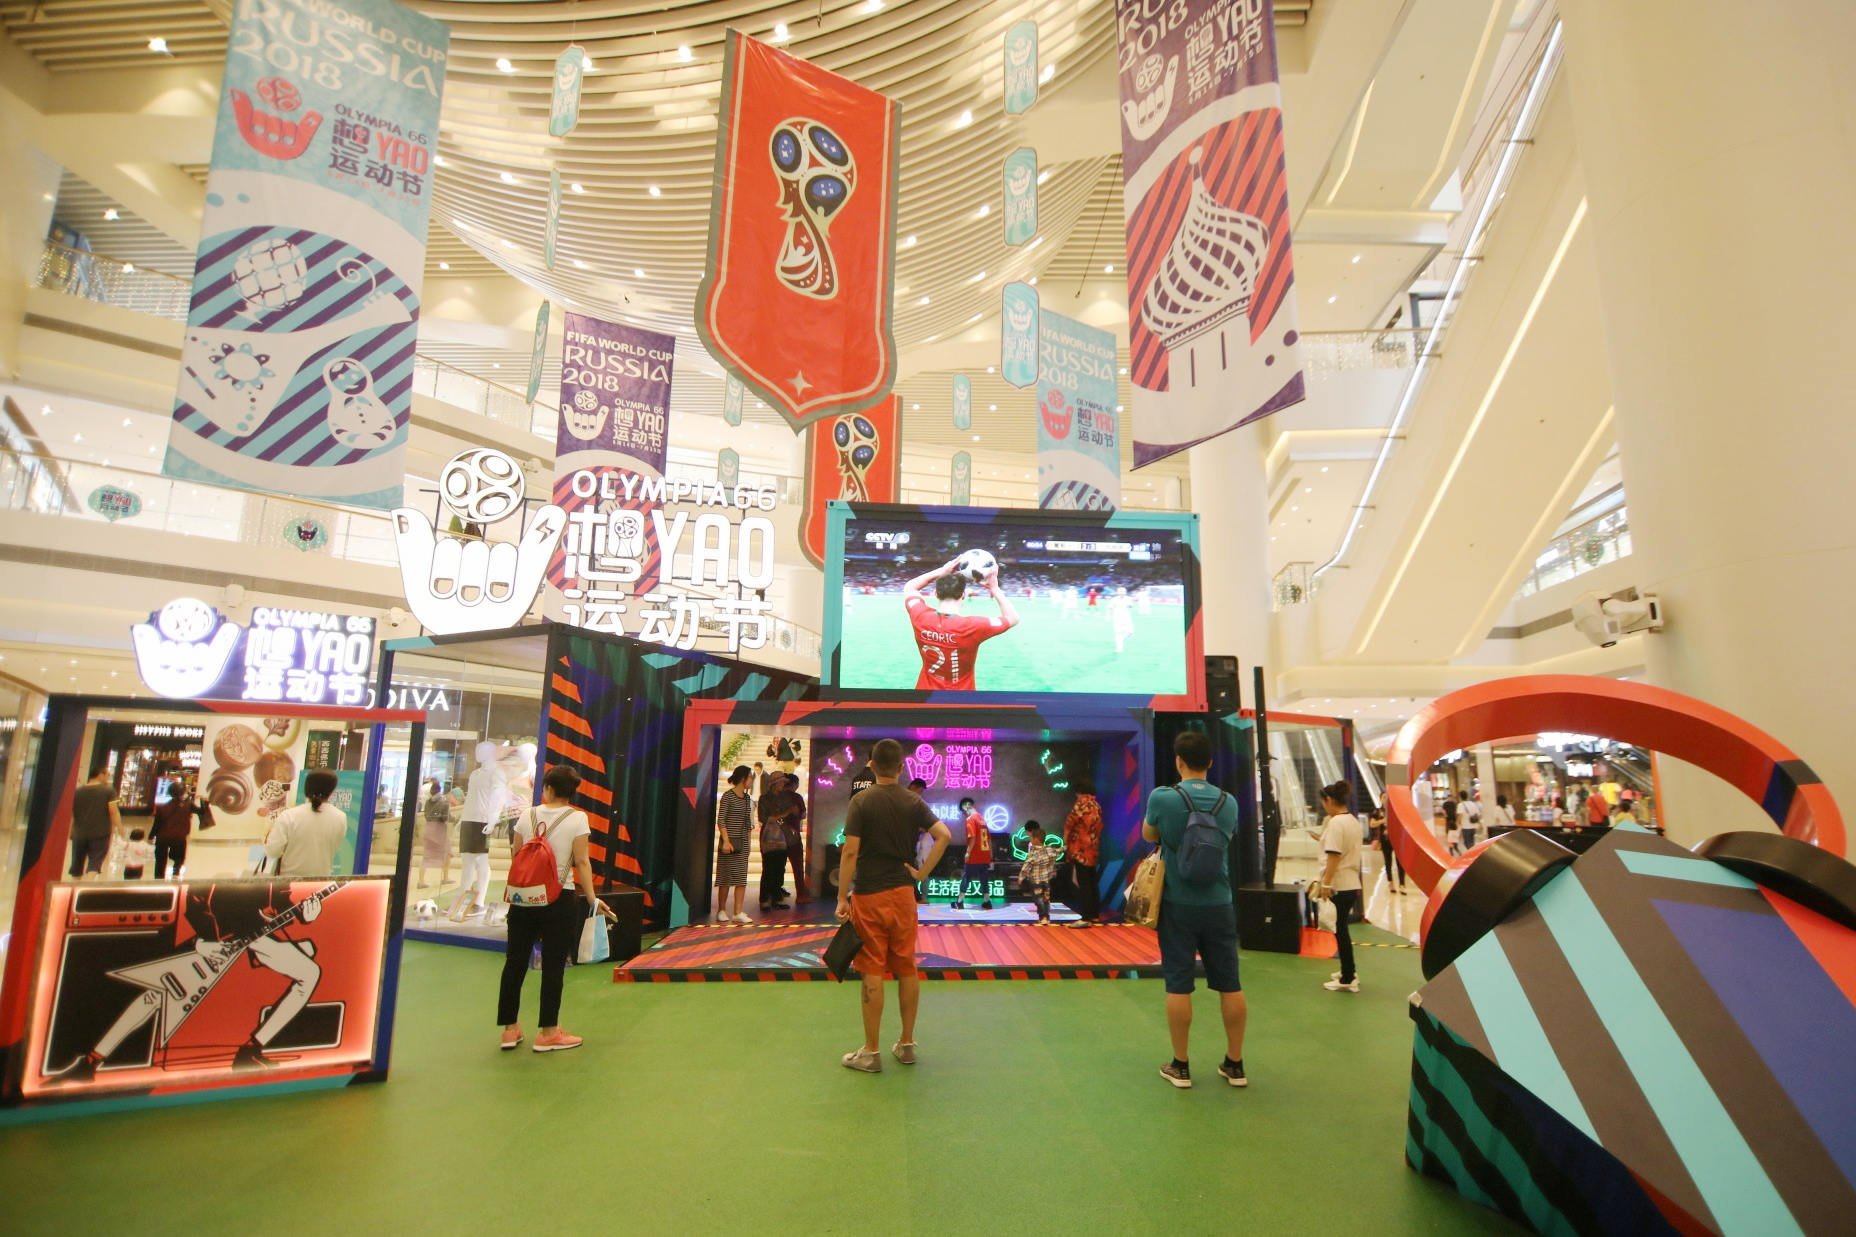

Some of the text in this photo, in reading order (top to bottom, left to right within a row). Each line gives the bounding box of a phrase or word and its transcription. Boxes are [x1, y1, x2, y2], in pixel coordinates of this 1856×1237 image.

[239, 0, 439, 98] RUSSIA
[401, 36, 446, 63] CUP
[1119, 0, 1189, 75] 2018
[232, 29, 343, 91] 2018
[1187, 17, 1263, 97] 运动节
[334, 103, 427, 145] OLYMPIA 66
[328, 146, 425, 197] 运动节
[566, 331, 674, 363] FIFA WORLD CUP
[1060, 331, 1096, 355] WORLD
[1097, 346, 1116, 360] CUP
[565, 345, 670, 385] RUSSIA
[1040, 342, 1115, 383] RUSSIA
[1040, 363, 1079, 392] 2018
[562, 367, 619, 392] 2018
[614, 398, 665, 415] OLYMPIA 66
[612, 425, 663, 448] 运动节
[1077, 427, 1115, 448] 运动节
[253, 607, 372, 632] OLYMPIA 66
[562, 588, 774, 653] 运动节
[920, 629, 957, 645] CEDRIC
[922, 644, 960, 684] 21
[242, 666, 367, 705] 运动节
[945, 745, 992, 754] OLYMPIA 66
[853, 781, 873, 790] STAFF
[944, 773, 991, 789] 运动节
